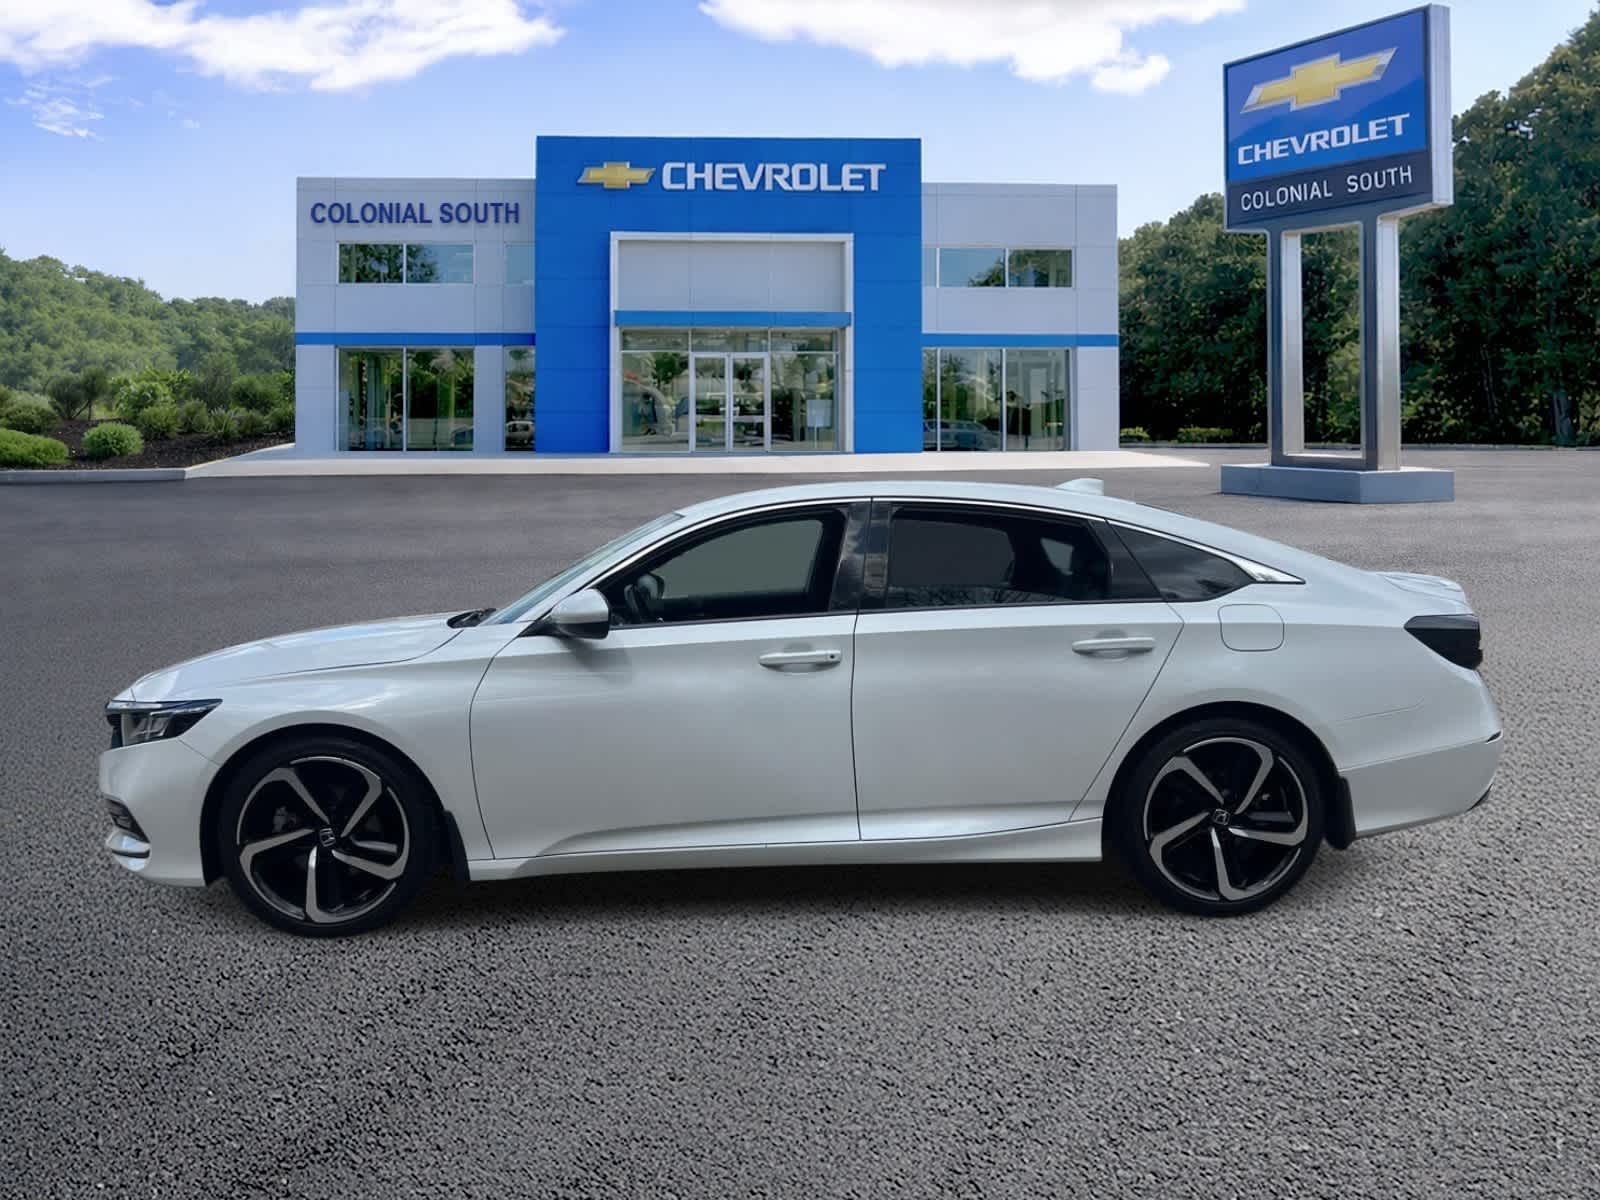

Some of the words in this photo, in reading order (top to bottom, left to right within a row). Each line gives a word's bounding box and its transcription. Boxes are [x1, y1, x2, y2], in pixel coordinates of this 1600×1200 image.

[1237, 113, 1410, 165] CHEVROLET
[662, 161, 886, 192] CHEVROLET
[1240, 180, 1333, 211] COLONIAL
[1346, 165, 1413, 193] SOUTH
[310, 204, 432, 224] COLONIAL
[439, 204, 521, 224] SOUTH
